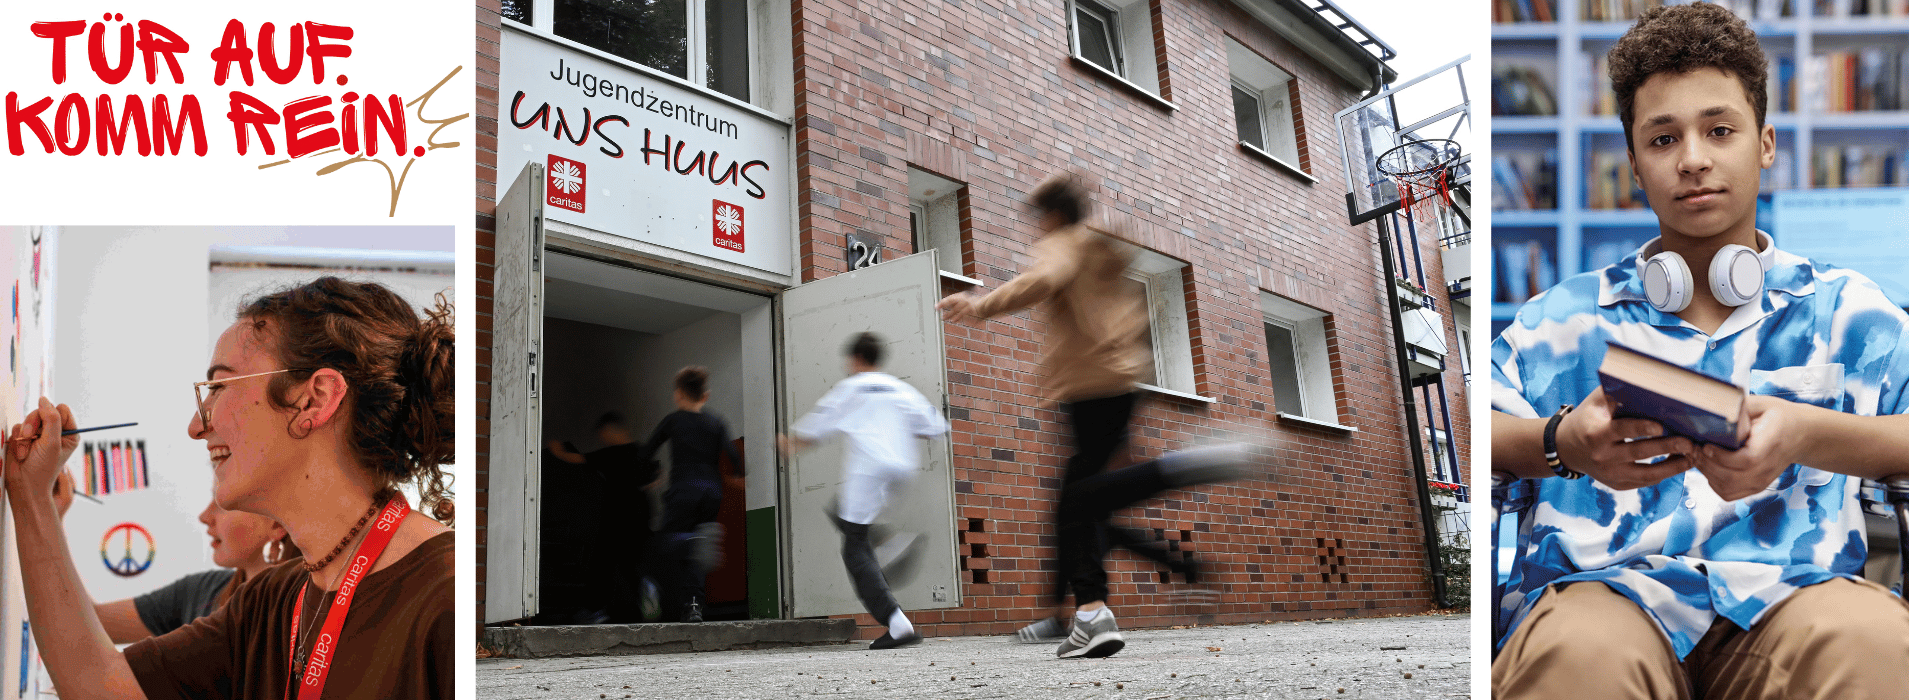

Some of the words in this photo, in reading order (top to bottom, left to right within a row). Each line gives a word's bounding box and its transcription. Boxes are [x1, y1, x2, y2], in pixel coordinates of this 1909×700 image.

[550, 58, 738, 139] Jugendzentrum
[510, 90, 630, 158] UNS
[640, 127, 770, 200] HUUS
[549, 195, 583, 211] caritas
[715, 237, 743, 251] caritas
[853, 241, 882, 270] 24
[336, 555, 368, 606] caritas
[305, 633, 332, 687] caritas
